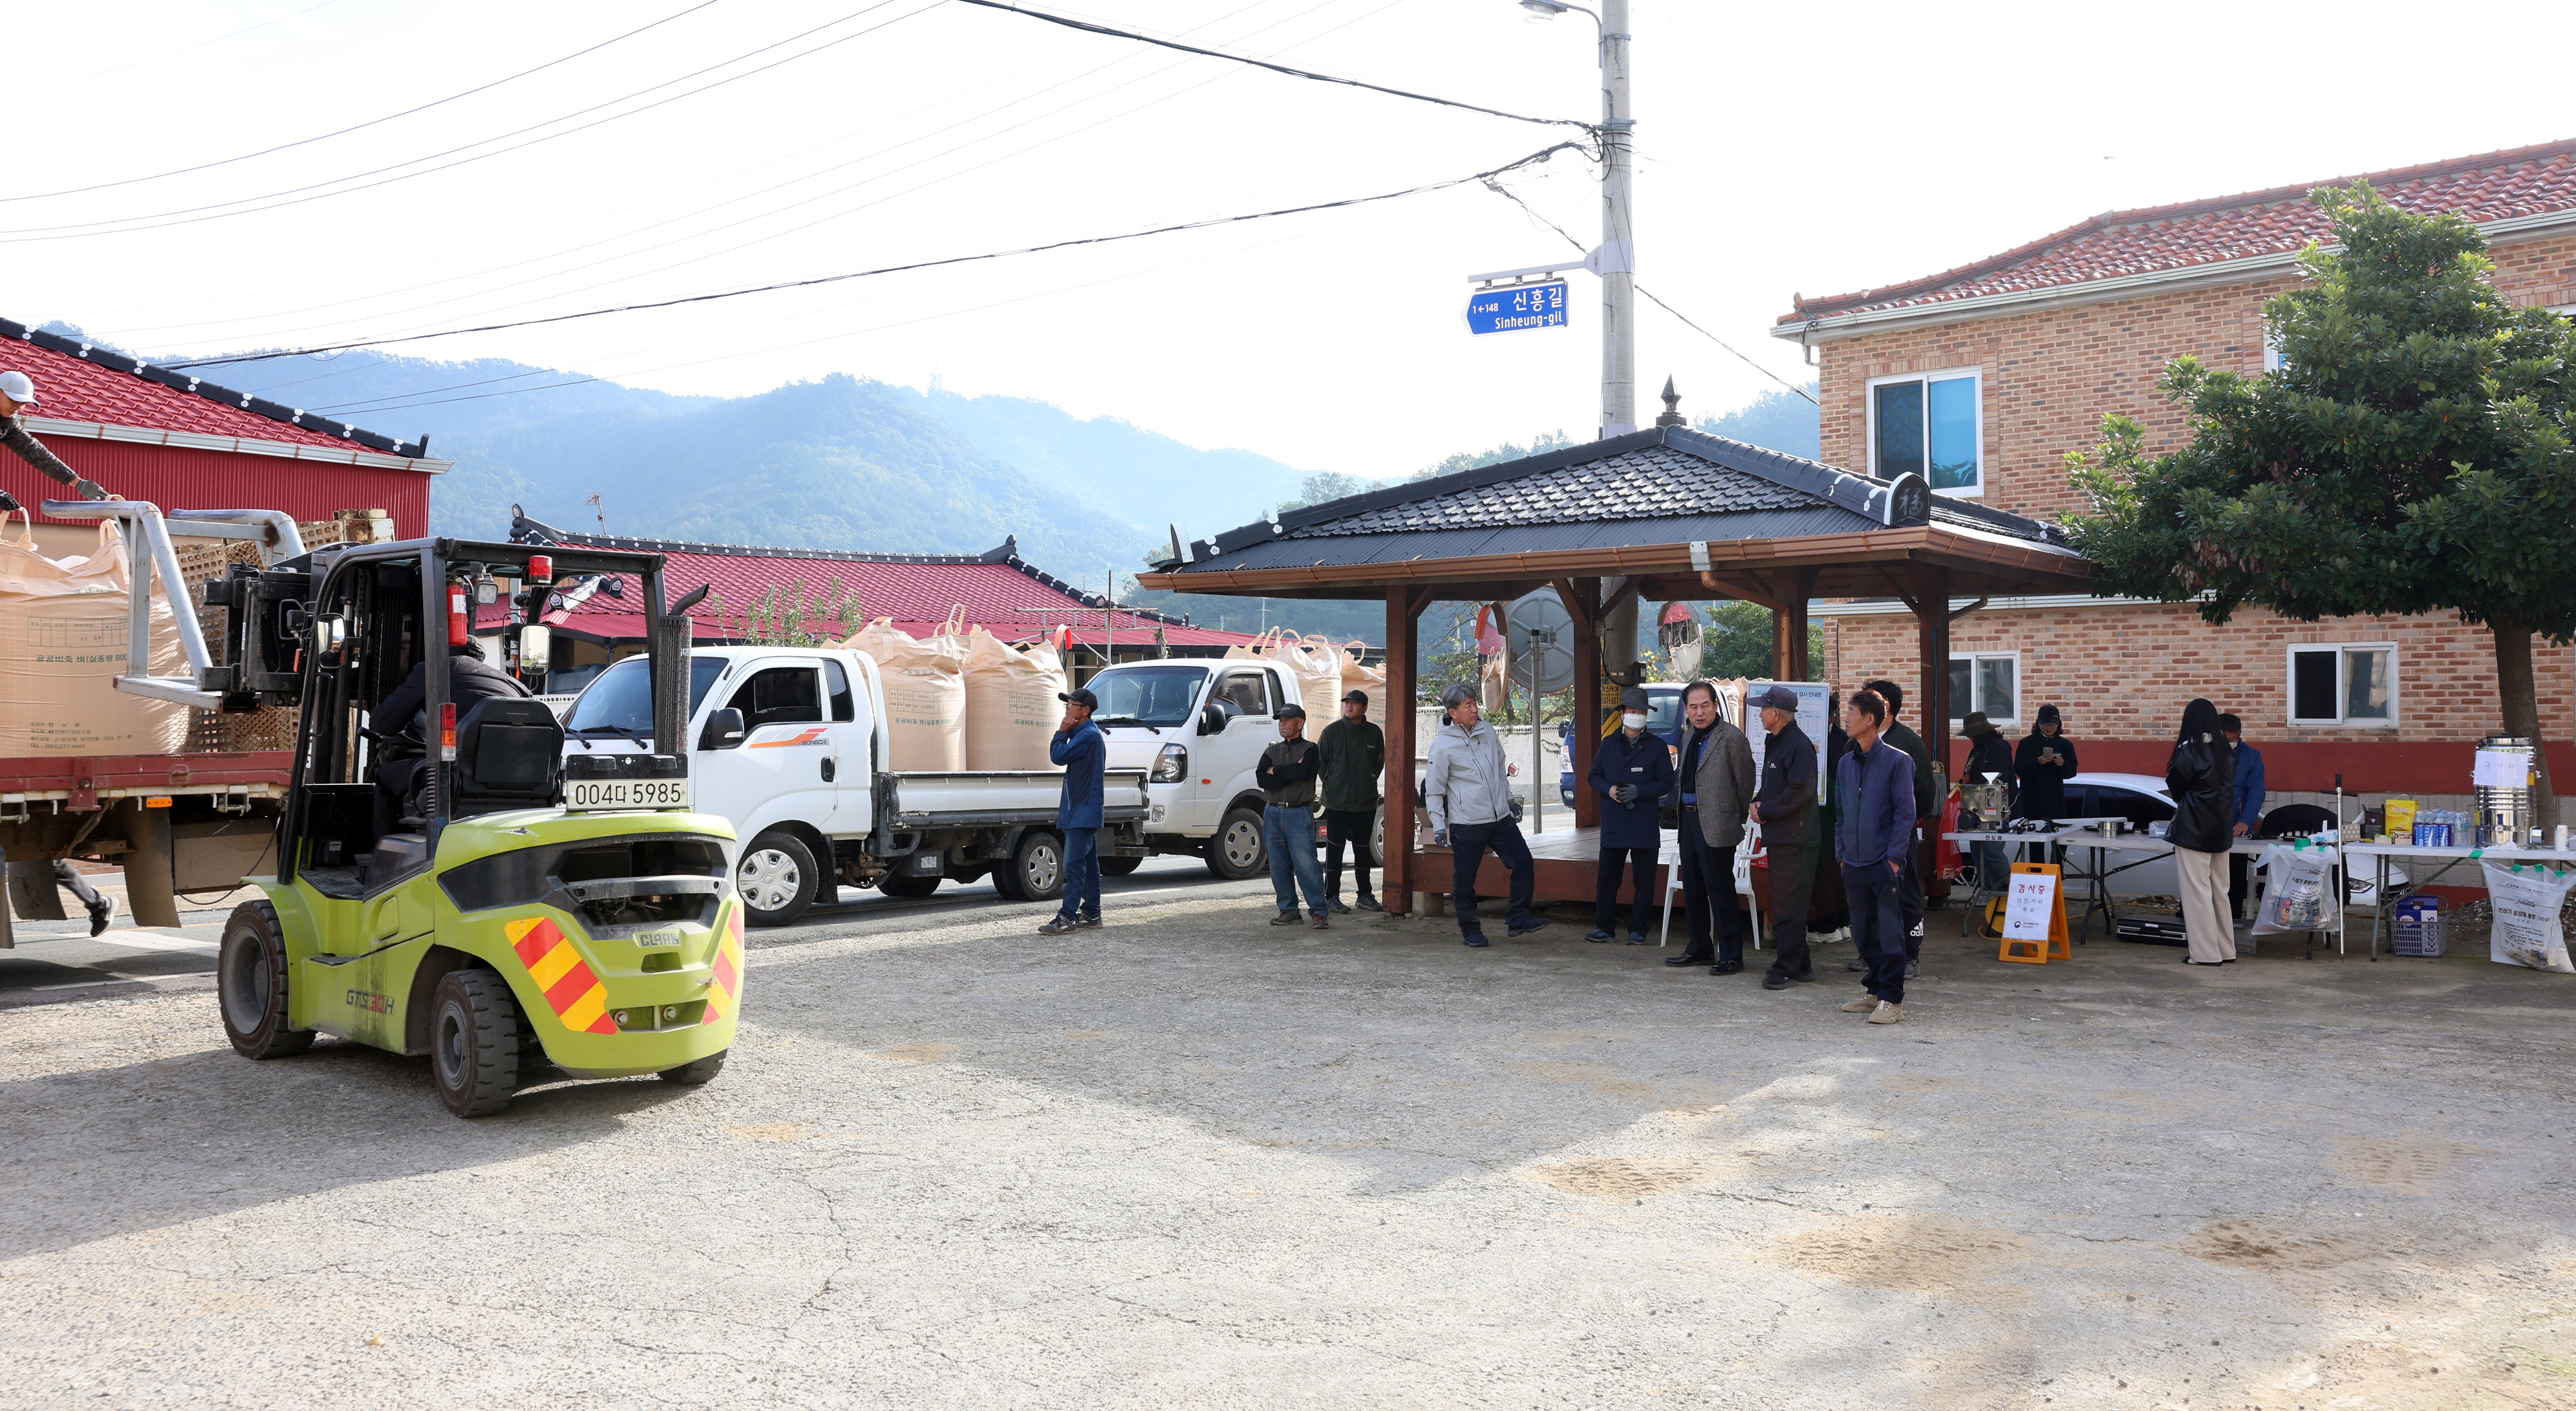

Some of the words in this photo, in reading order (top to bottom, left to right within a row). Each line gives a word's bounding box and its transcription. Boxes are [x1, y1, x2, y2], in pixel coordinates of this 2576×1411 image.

[1513, 286, 1563, 312] 신흥길
[1485, 303, 1499, 313] 148
[1495, 310, 1563, 330] Sinheung-gil
[36, 654, 73, 663] 공공비축
[575, 784, 627, 805] 004다
[633, 783, 681, 804] 5985
[2516, 899, 2532, 907] Jindo
[639, 933, 680, 947] CLARK
[346, 989, 394, 1014] GTS30H
